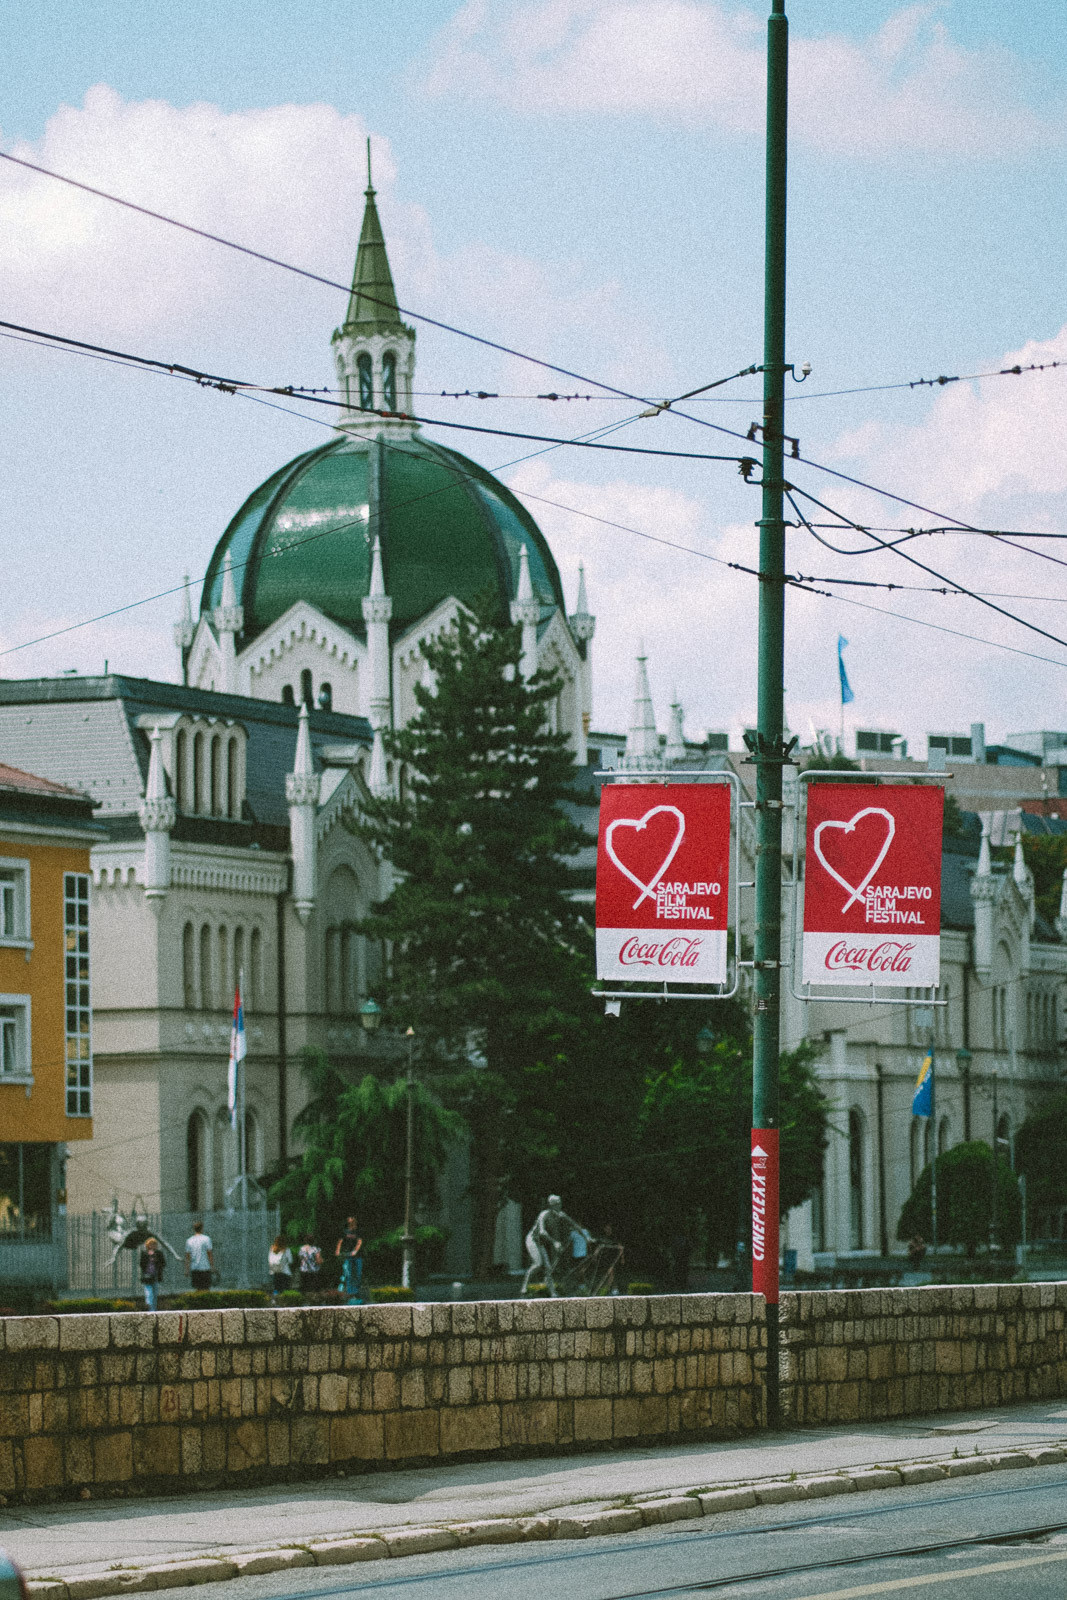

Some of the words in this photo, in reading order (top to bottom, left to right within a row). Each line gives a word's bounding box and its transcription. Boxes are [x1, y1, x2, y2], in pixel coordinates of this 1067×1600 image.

[656, 882, 721, 895] SARAJEVO
[865, 885, 932, 899] SARAJEVO
[656, 894, 687, 907] FILM
[865, 898, 896, 911] FILM
[656, 906, 714, 919] FESTIVAL
[865, 910, 925, 924] FESTIVAL
[751, 1167, 766, 1261] CINEPLEXX
